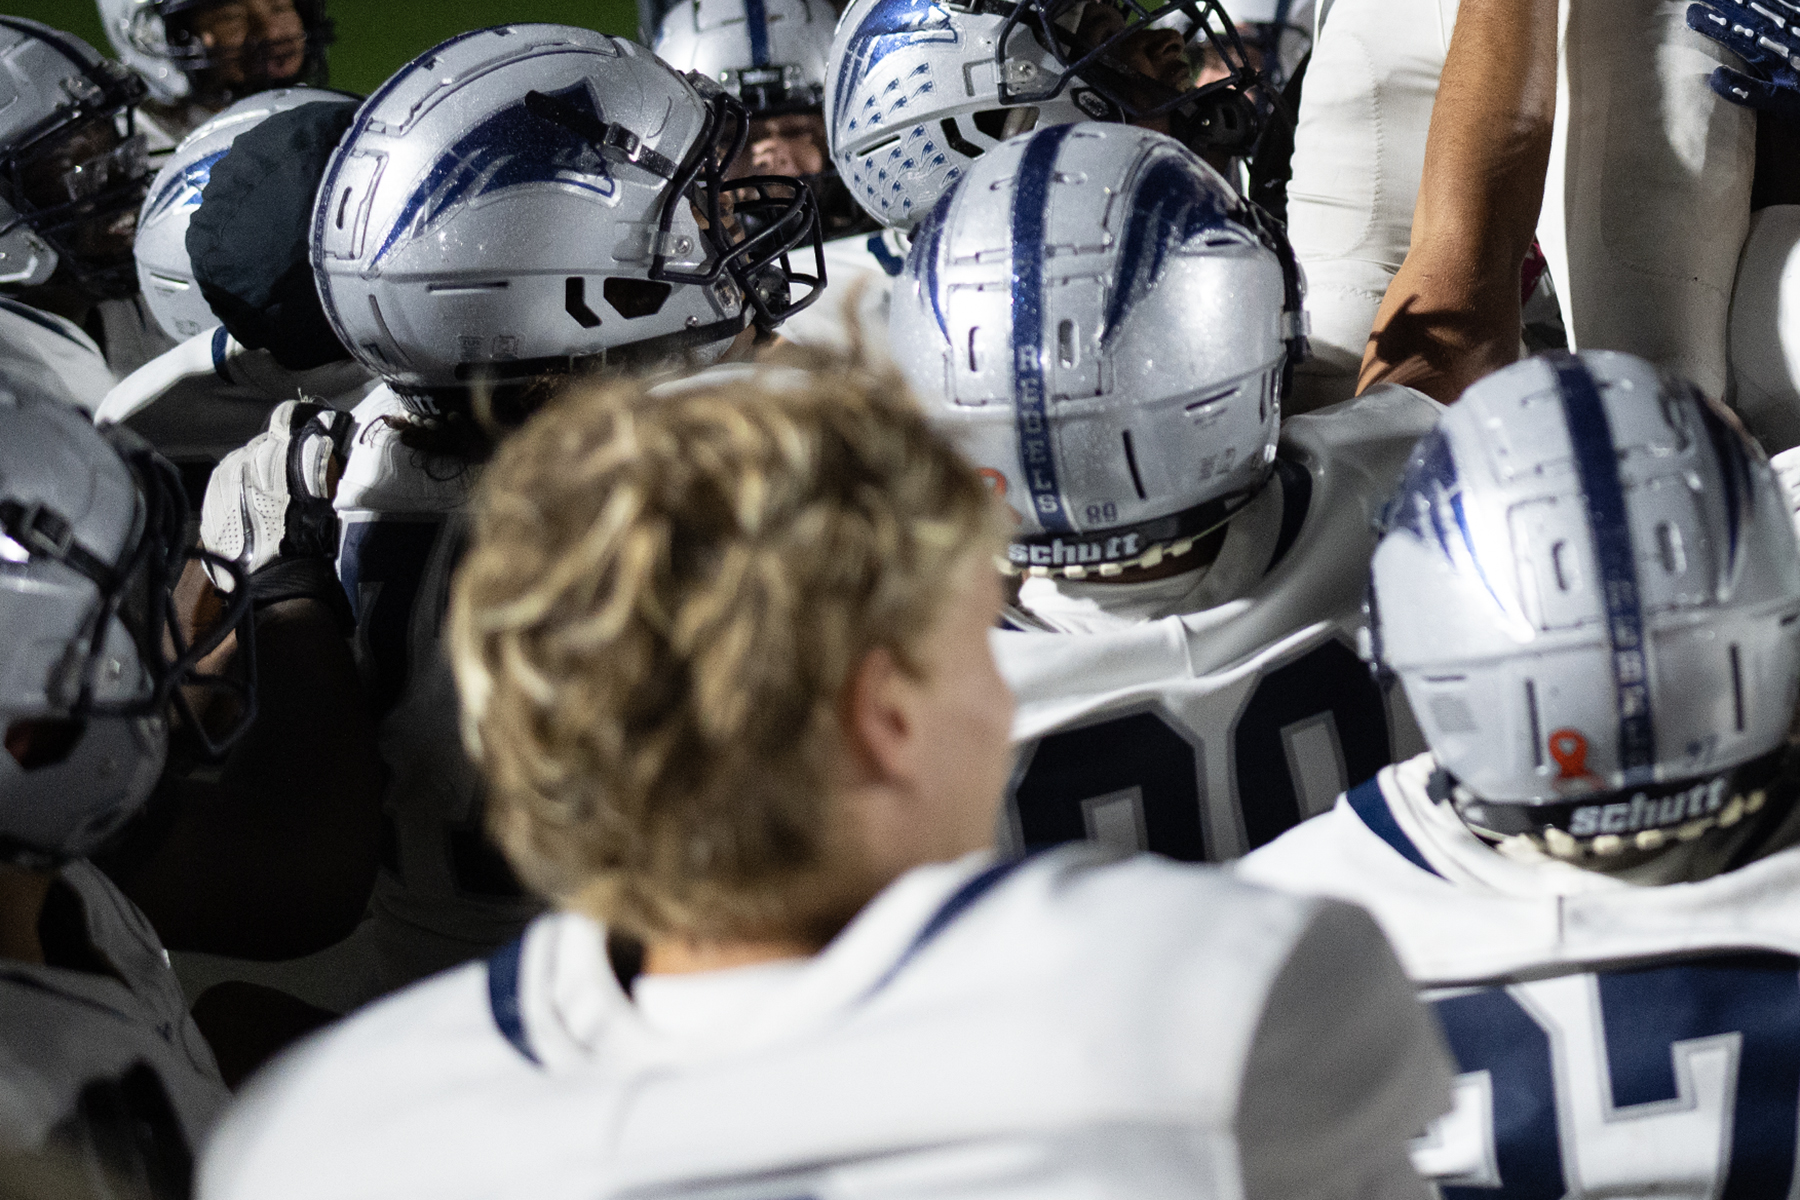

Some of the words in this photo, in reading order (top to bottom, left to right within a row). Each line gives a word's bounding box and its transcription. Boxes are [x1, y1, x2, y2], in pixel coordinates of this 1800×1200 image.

[1017, 345, 1058, 513] REBELS
[1008, 530, 1140, 567] schutt
[1570, 776, 1727, 837] schutt
